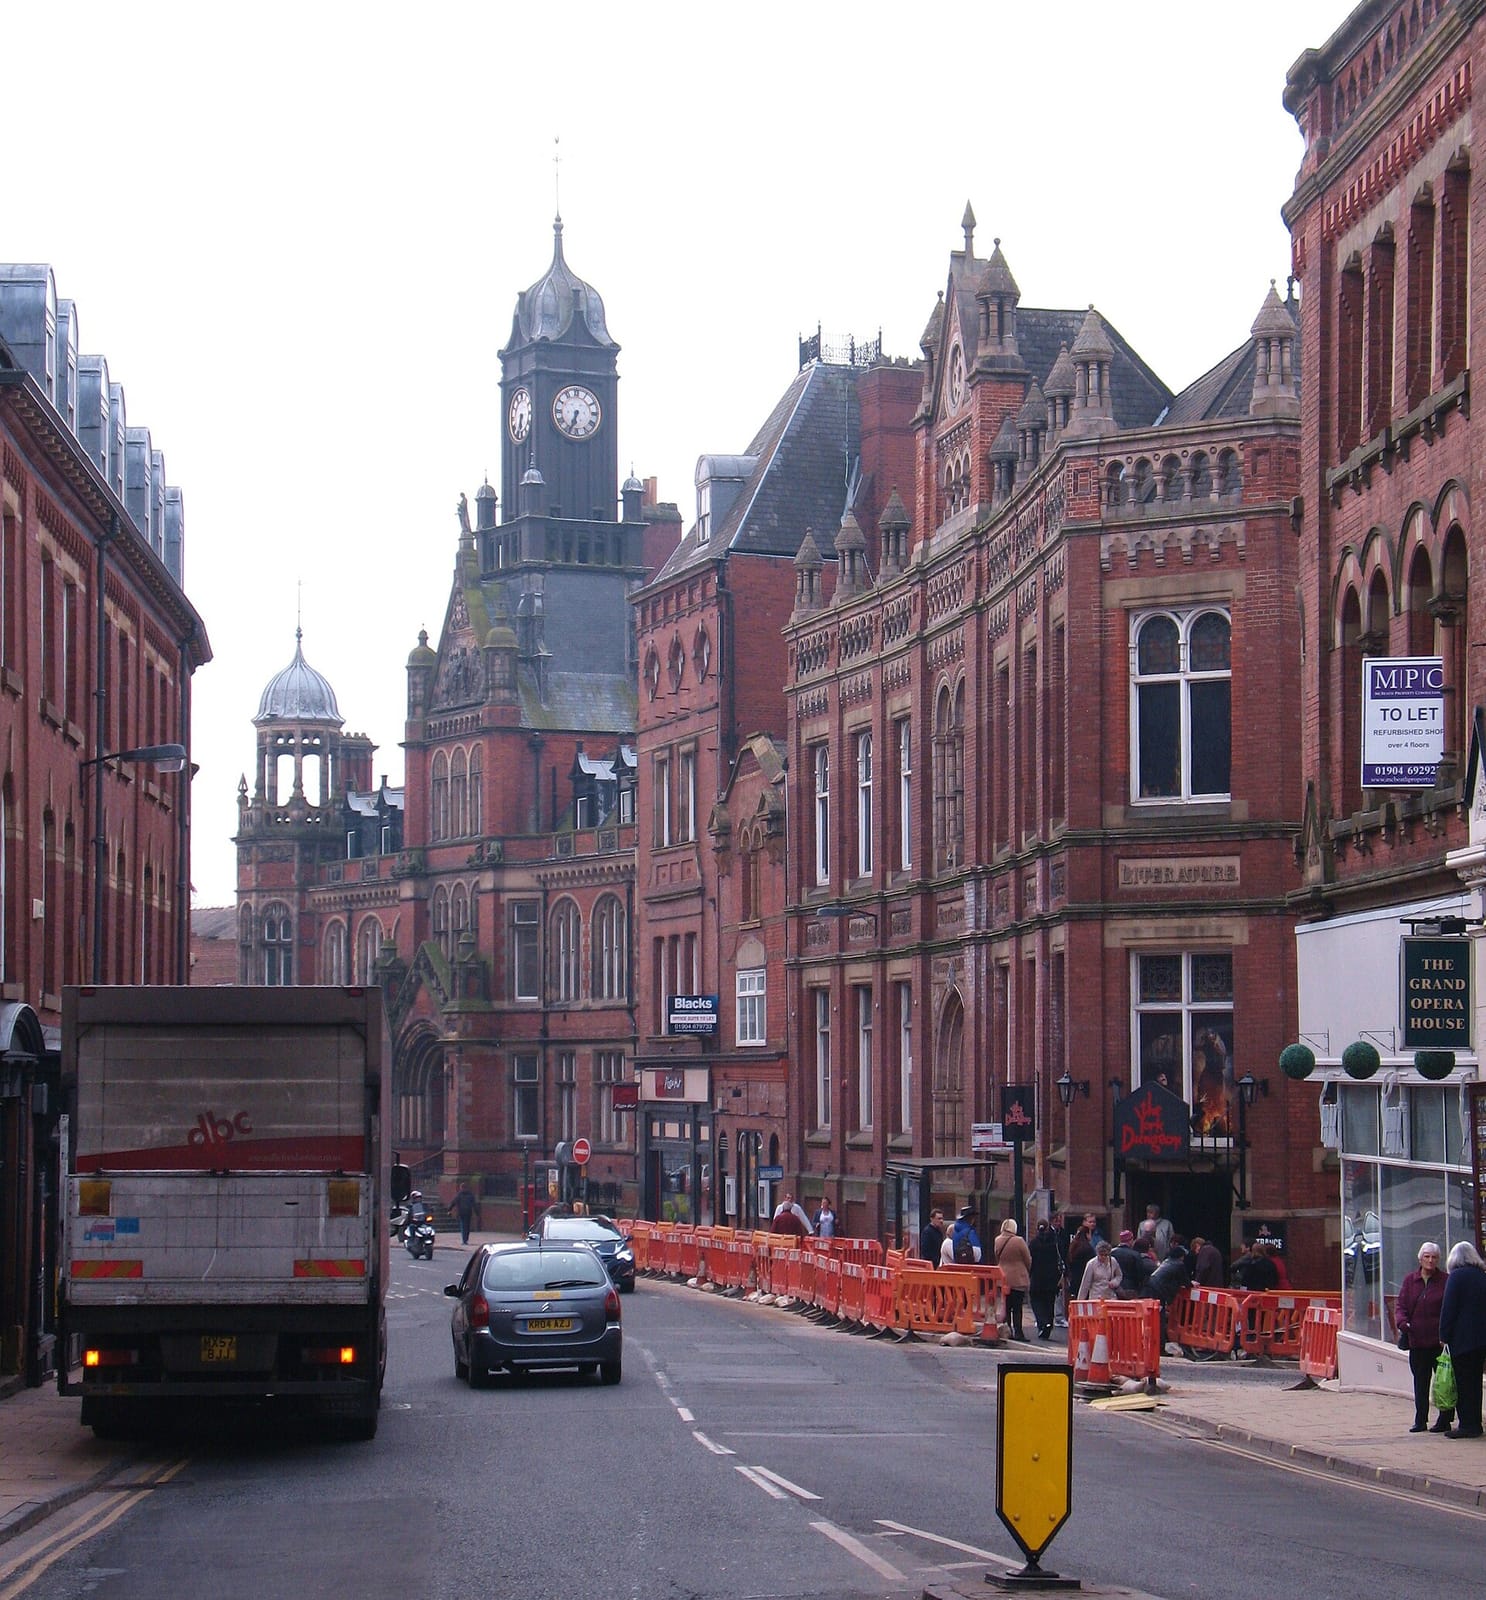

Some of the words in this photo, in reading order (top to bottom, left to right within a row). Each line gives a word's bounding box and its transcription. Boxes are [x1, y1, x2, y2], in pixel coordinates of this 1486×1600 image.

[1380, 708, 1402, 721] TO
[1408, 707, 1438, 721] LET
[1375, 766, 1403, 775] 01904
[1407, 766, 1440, 775] 69292
[1422, 959, 1454, 970] THE
[1409, 978, 1466, 990] GRAND
[674, 997, 713, 1009] Blacks
[1410, 998, 1464, 1010] OPERA
[1410, 1018, 1465, 1030] HOUSE
[187, 1110, 253, 1150] dbc
[528, 1320, 551, 1329] KR04
[553, 1320, 571, 1328] AZJ
